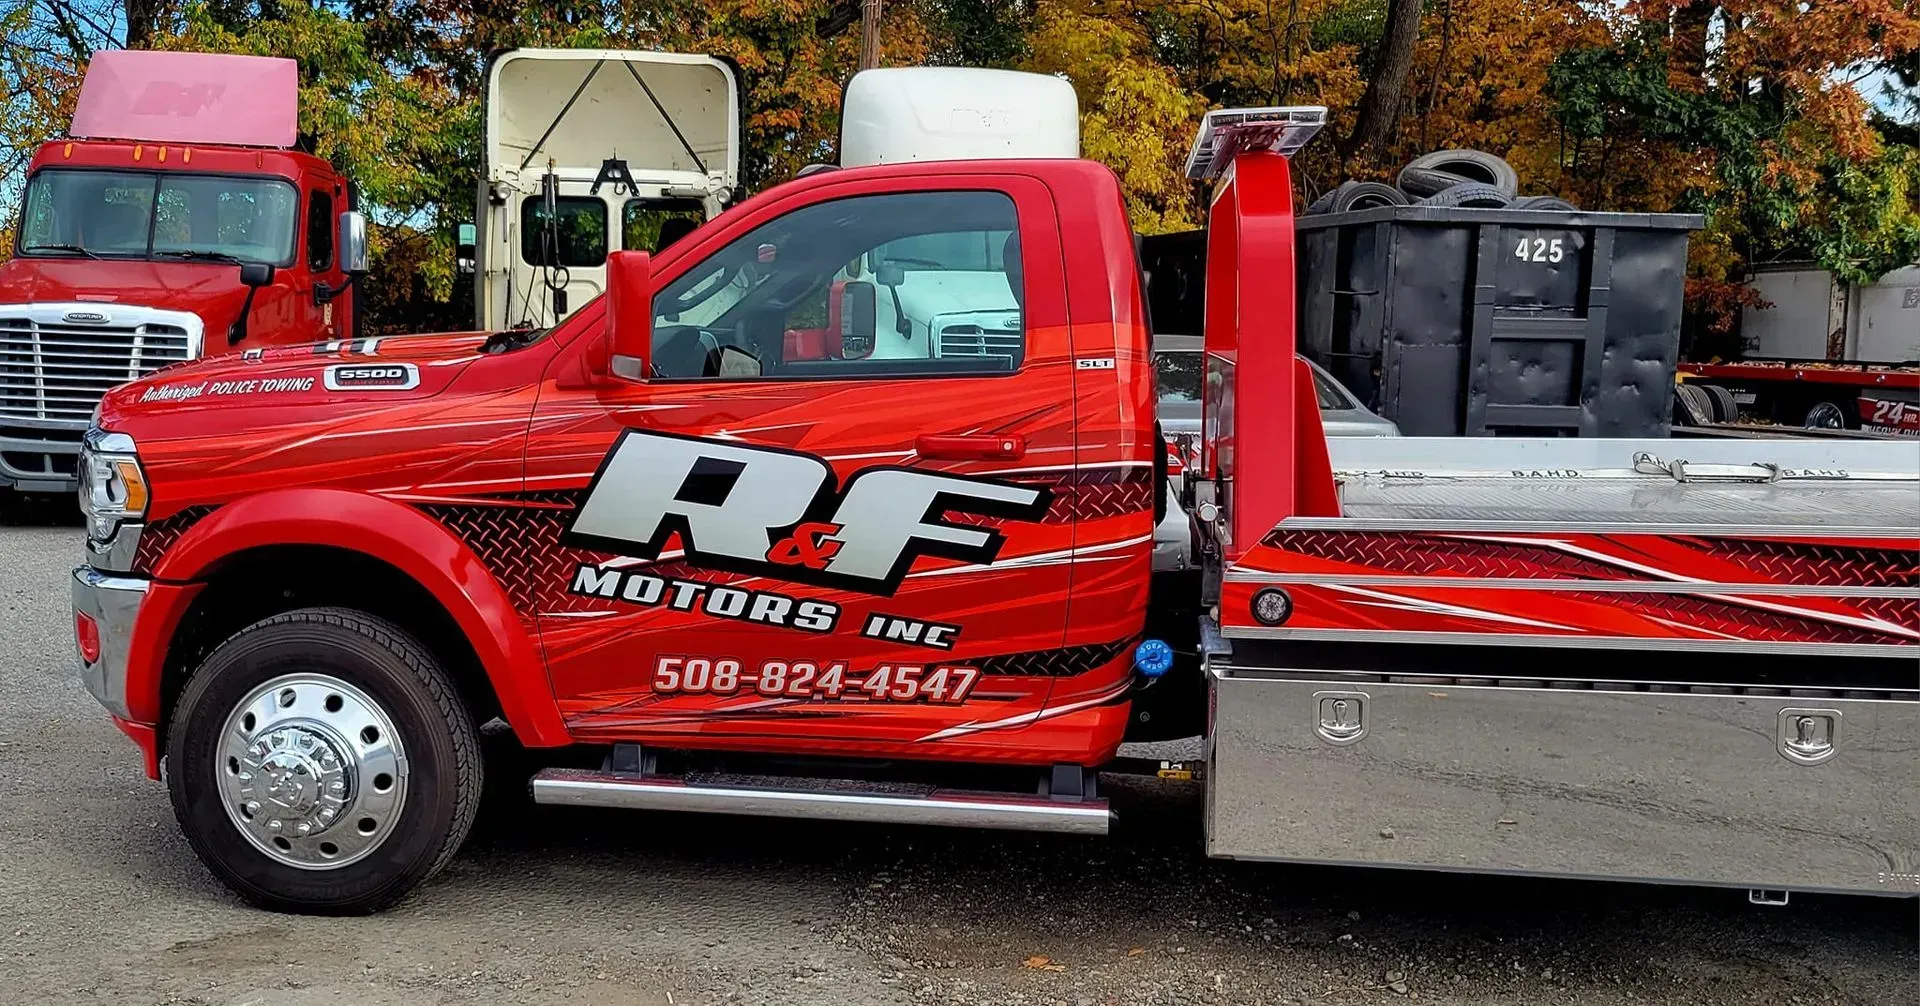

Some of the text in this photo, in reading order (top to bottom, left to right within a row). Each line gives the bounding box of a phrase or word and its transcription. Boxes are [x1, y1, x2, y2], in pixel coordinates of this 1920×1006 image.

[1514, 238, 1563, 263] 425
[340, 369, 402, 379] 5500
[1079, 359, 1110, 368] SLT
[139, 377, 315, 403] Authorized POLICE TOWING
[1872, 400, 1905, 424] 24
[568, 430, 1042, 582] R&F
[572, 564, 960, 648] MOTORS INC
[655, 657, 980, 700] 508-824-4547
